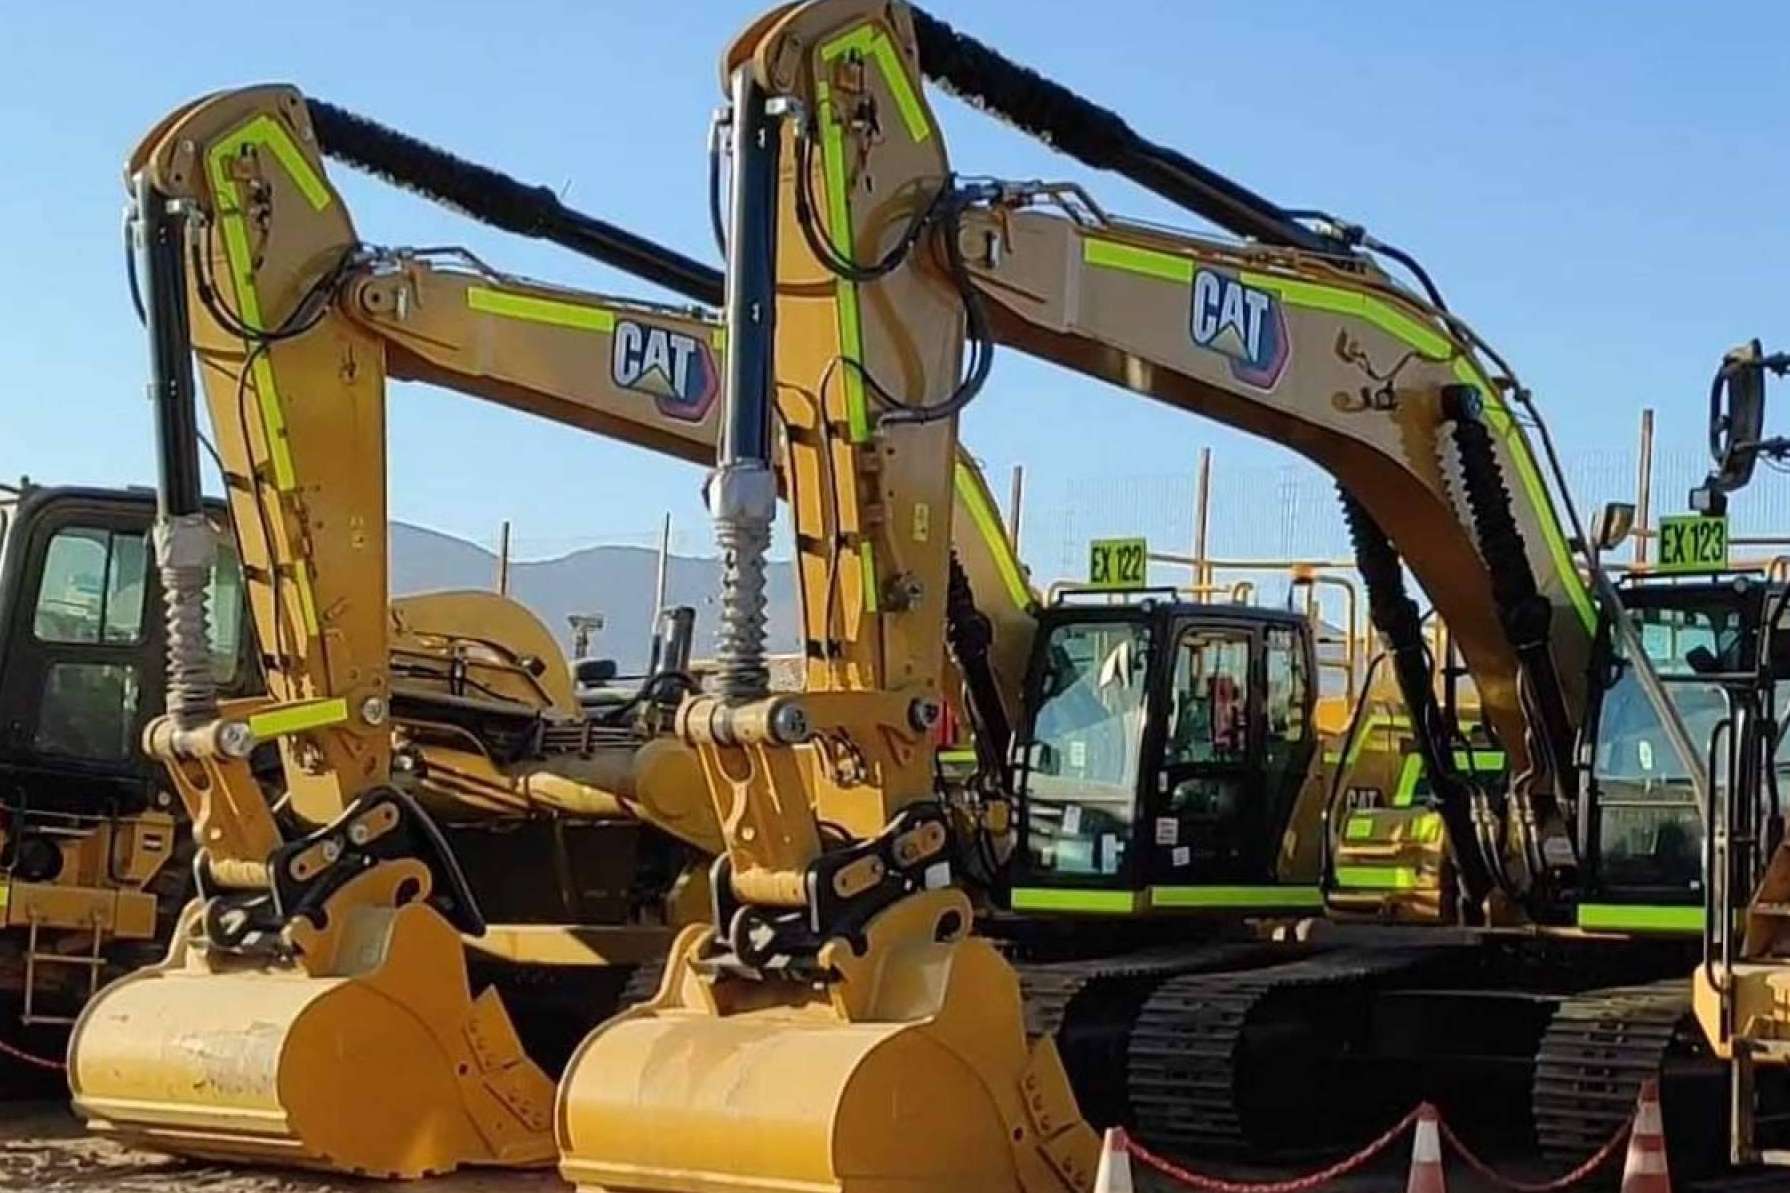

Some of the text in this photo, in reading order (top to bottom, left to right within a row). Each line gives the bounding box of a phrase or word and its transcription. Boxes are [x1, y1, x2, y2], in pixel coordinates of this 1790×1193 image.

[1191, 268, 1270, 364] CAT
[614, 320, 696, 400] CAT
[1091, 544, 1141, 583] EX 122
[1660, 521, 1724, 563] EX 123
